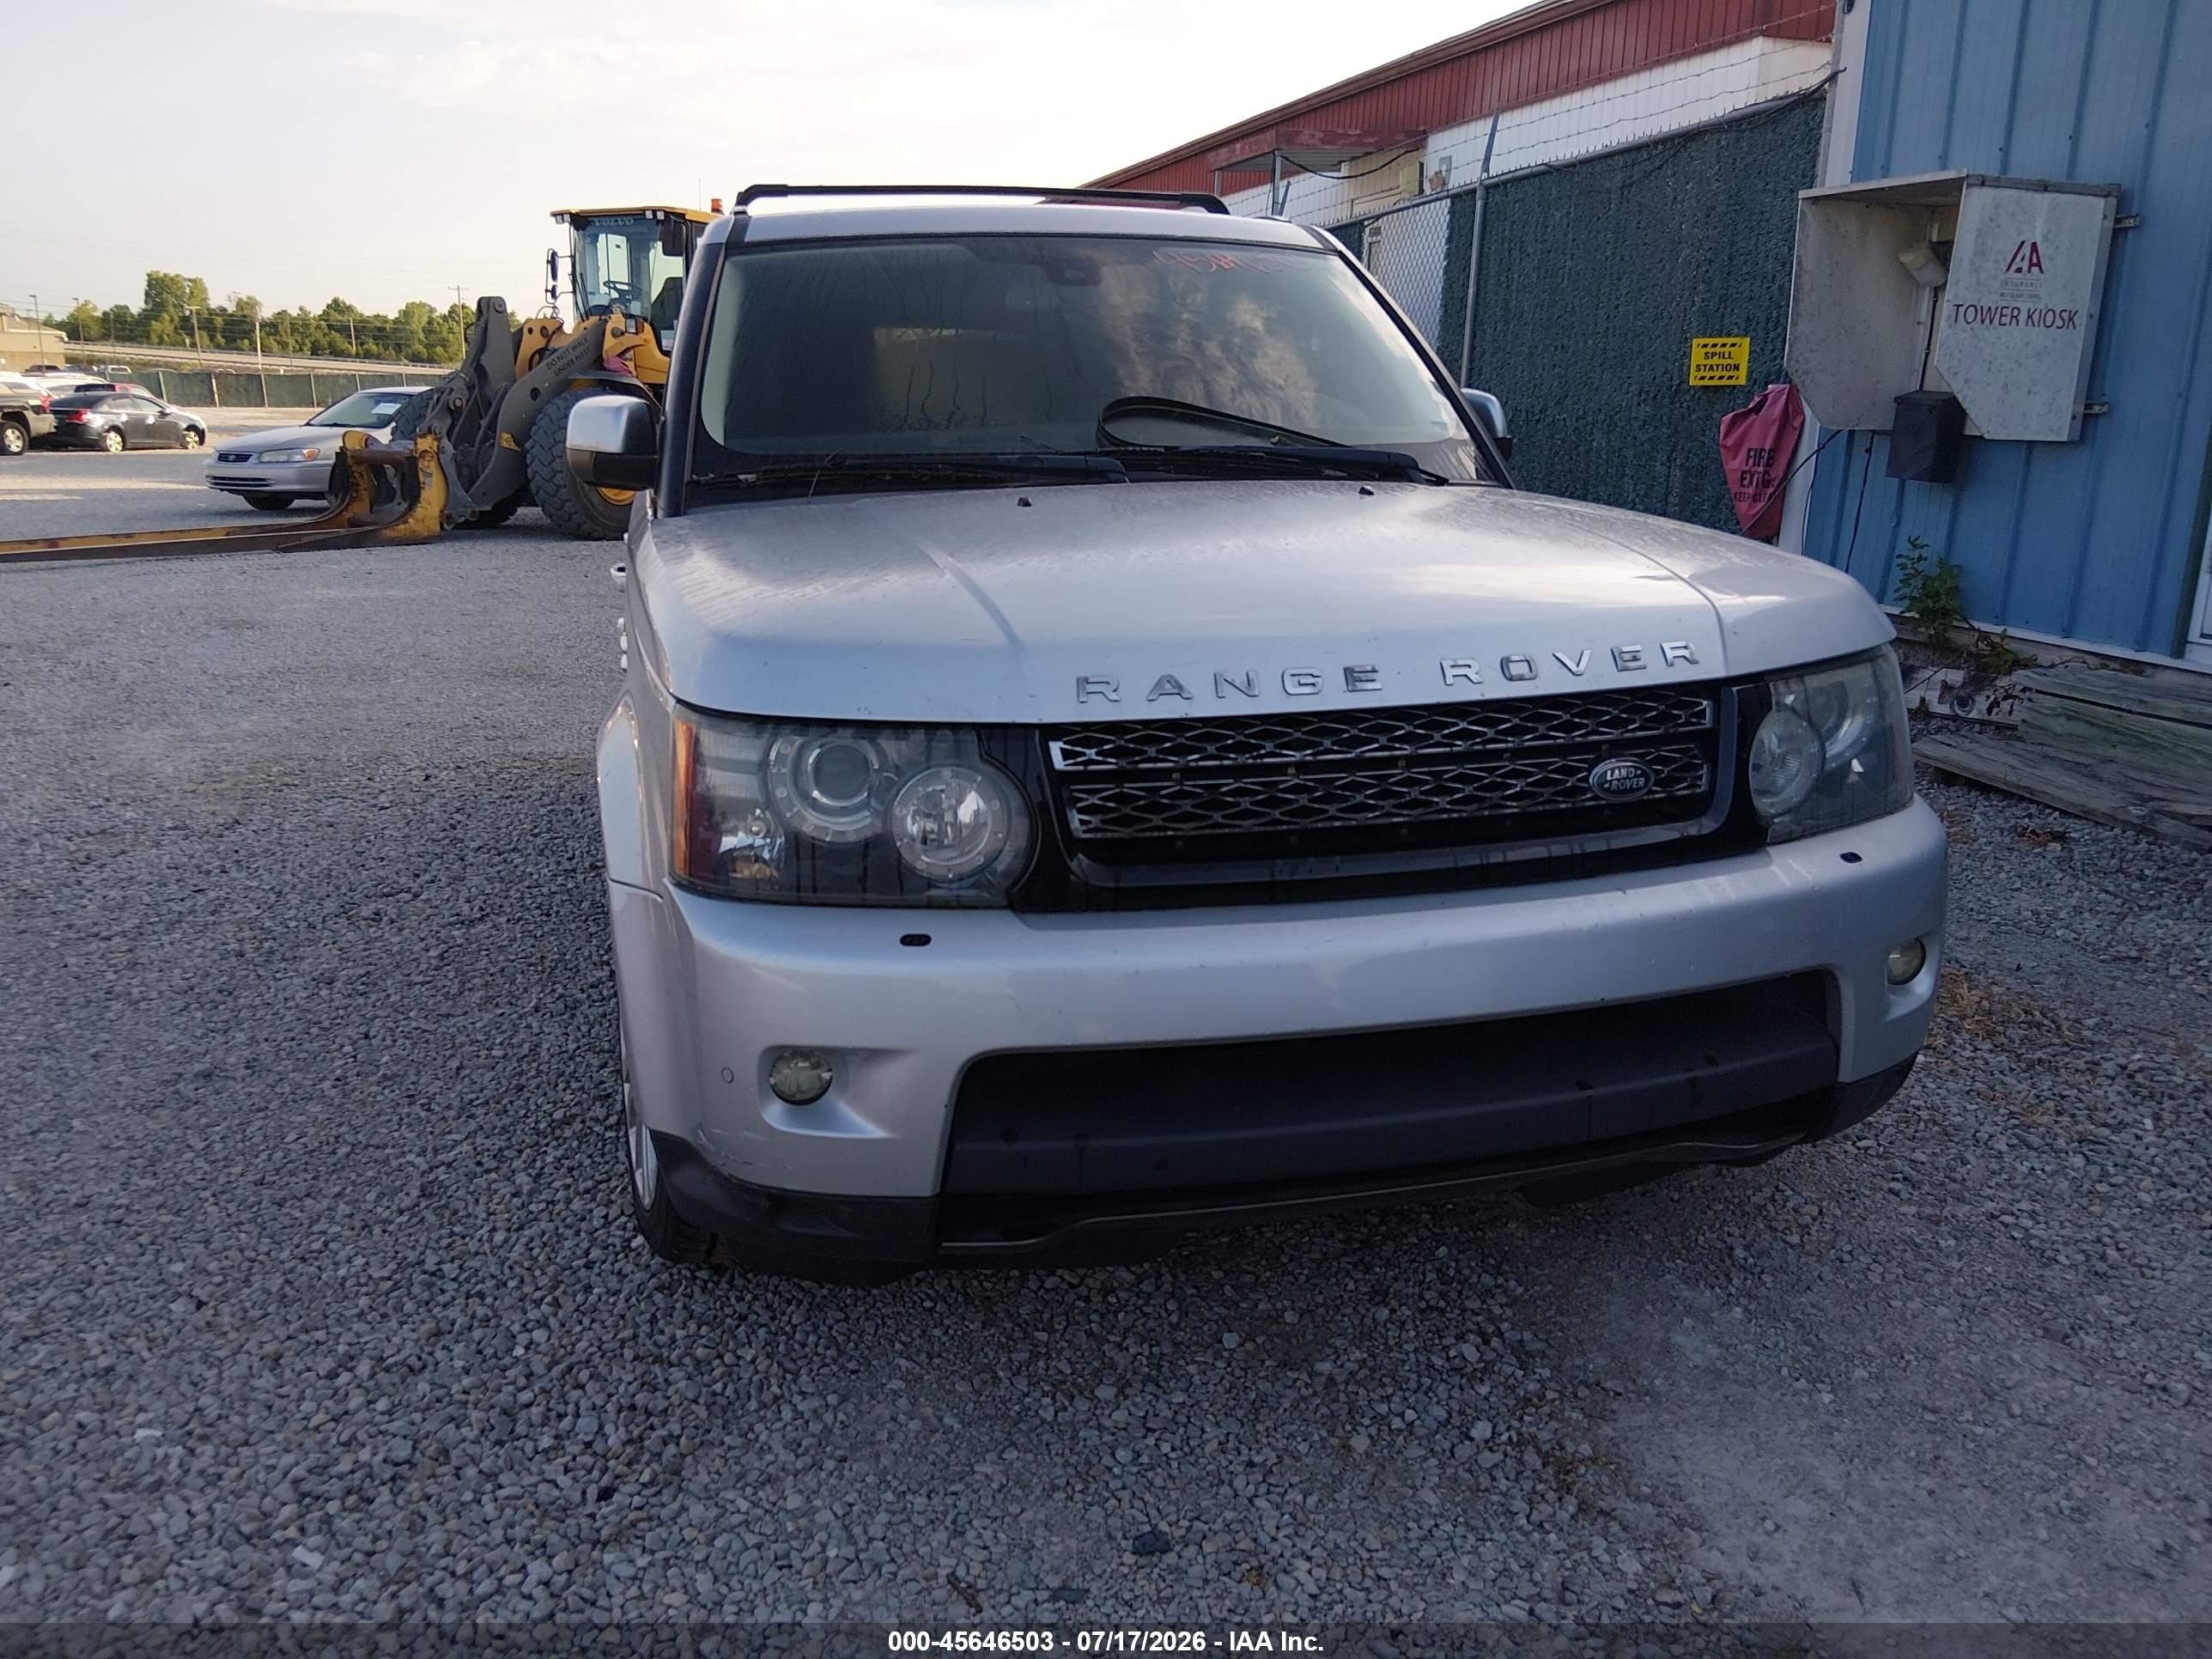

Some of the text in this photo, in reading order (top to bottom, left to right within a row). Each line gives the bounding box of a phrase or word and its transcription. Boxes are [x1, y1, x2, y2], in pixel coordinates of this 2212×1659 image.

[594, 216, 634, 226] VOLVO
[1953, 303, 2079, 330] TOWER KIOSK
[556, 349, 570, 361] NOT
[1703, 350, 1734, 360] SPILL
[1695, 362, 1740, 373] STATION
[1745, 447, 1775, 468] FIRE
[1733, 491, 1751, 502] KEEP
[1076, 640, 1699, 703] RANGE ROVER
[1607, 768, 1636, 781] LAND
[1610, 777, 1646, 791] ROVER
